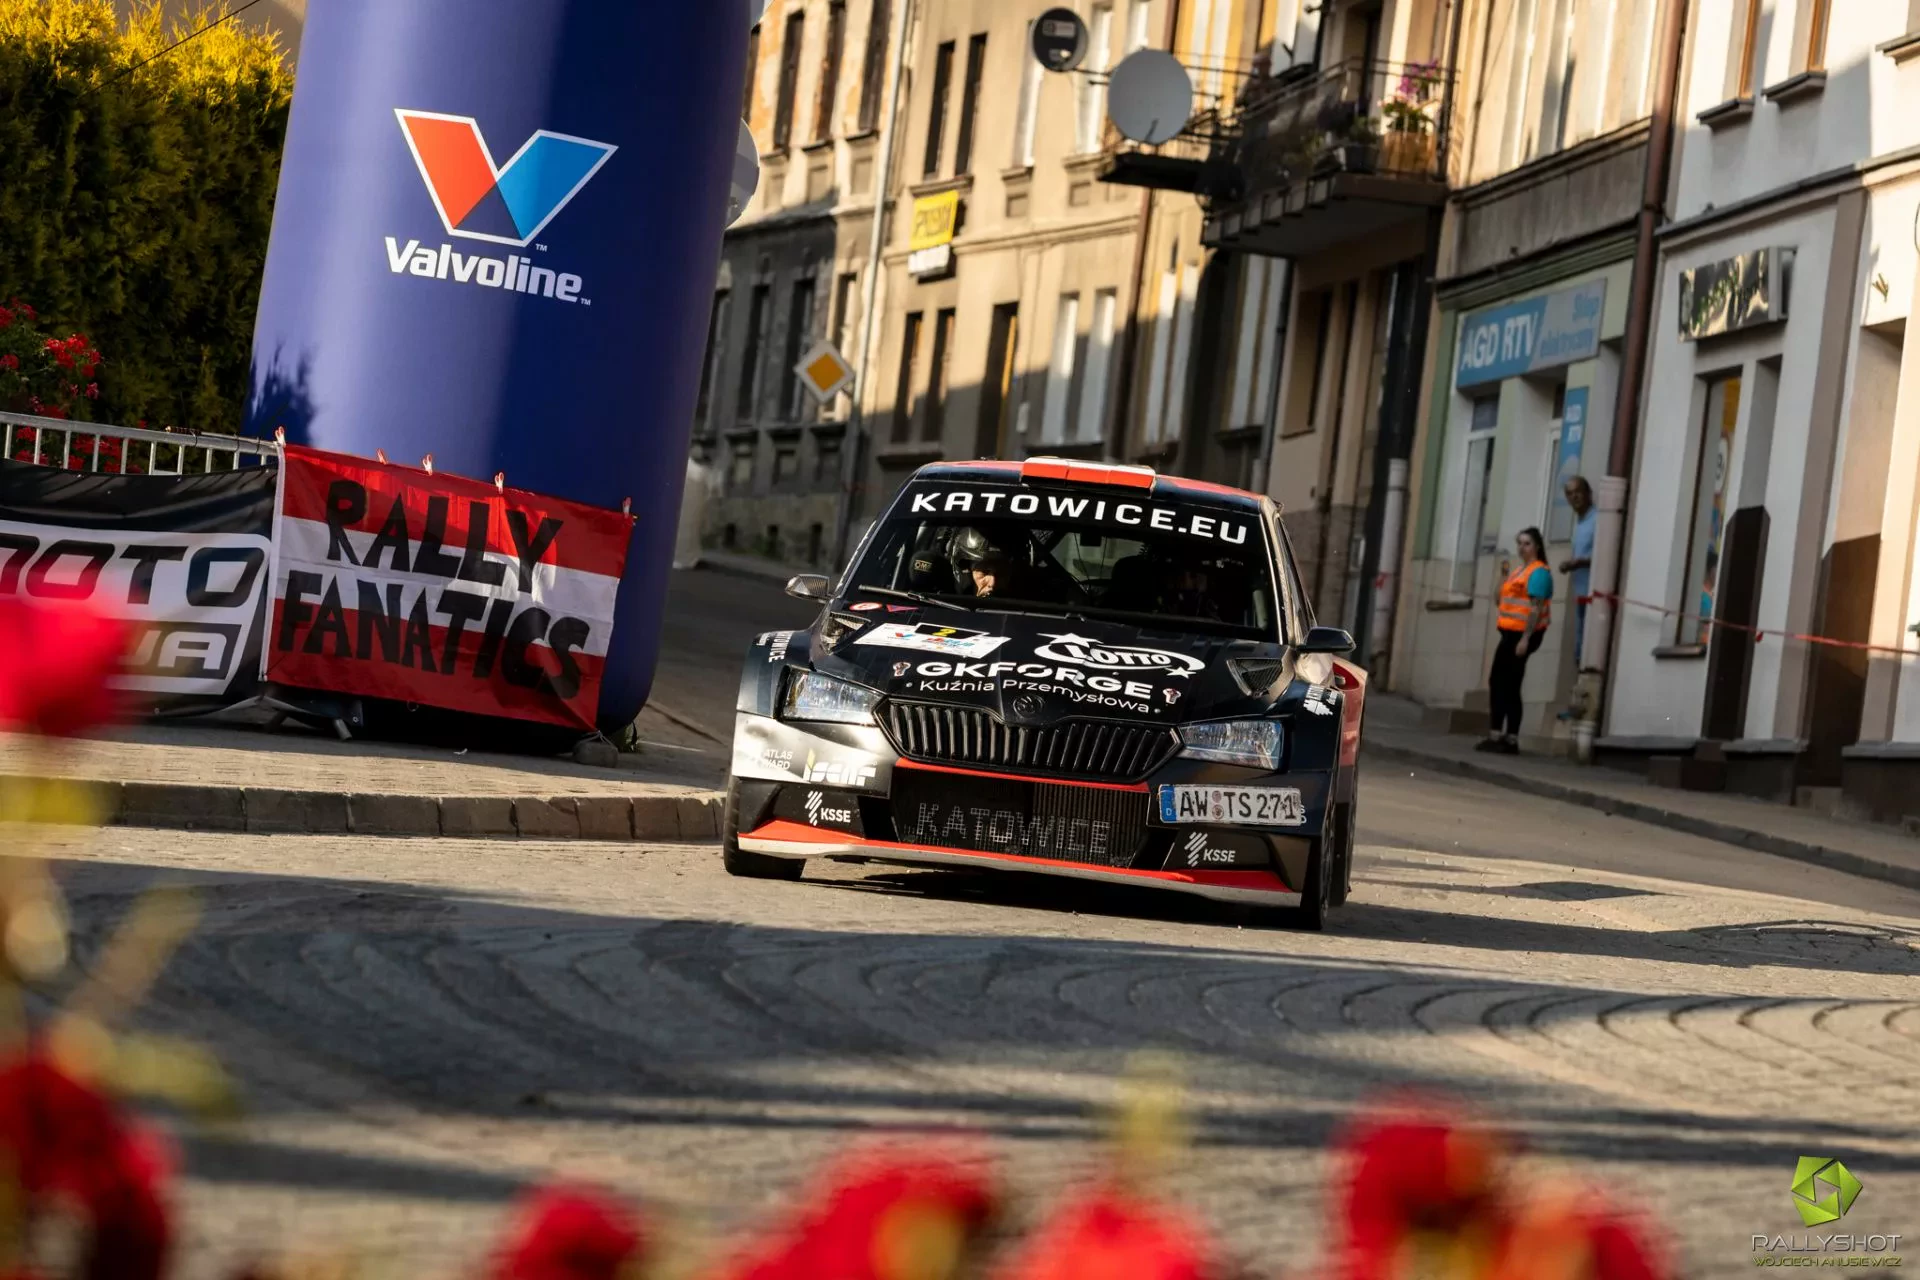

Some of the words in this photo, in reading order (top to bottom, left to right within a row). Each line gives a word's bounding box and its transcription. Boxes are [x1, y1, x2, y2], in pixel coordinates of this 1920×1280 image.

[384, 236, 583, 303] Valvoline
[1459, 323, 1499, 371] AGD
[1501, 312, 1539, 362] RTV
[326, 479, 564, 594] RALLY
[911, 492, 1248, 545] KATOWICE.EU
[277, 569, 591, 700] FANATICS
[1064, 644, 1172, 665] LOTTO
[916, 661, 1154, 699] GKFORGE
[919, 679, 996, 691] Kuźnia
[1002, 679, 1150, 714] Przemysłowa
[820, 807, 851, 823] KSSE
[1179, 790, 1208, 818] AW
[1223, 792, 1252, 818] TS
[916, 802, 1111, 854] KATOWICE
[1203, 849, 1236, 862] KSSE
